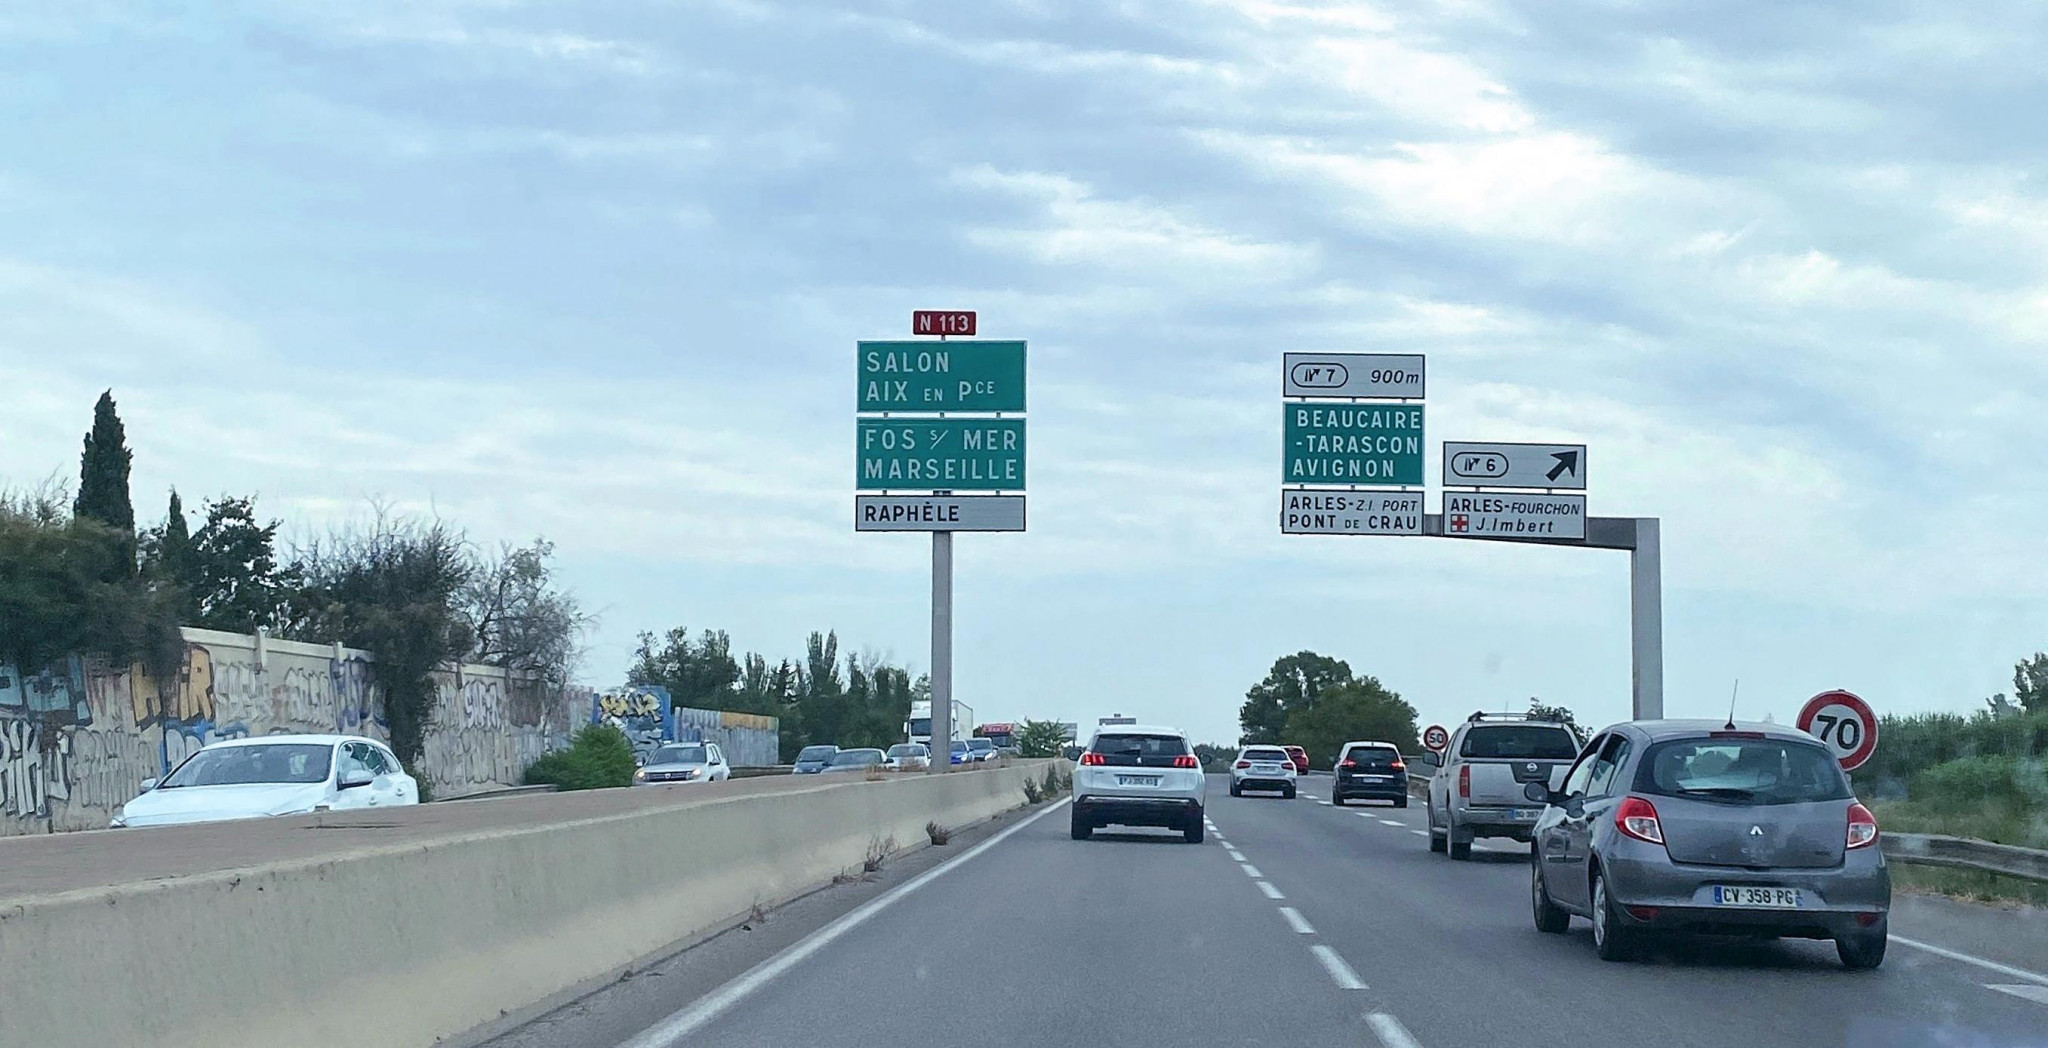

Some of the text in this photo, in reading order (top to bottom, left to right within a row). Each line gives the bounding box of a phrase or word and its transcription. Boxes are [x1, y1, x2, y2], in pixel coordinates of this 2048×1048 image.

[920, 315, 969, 332] N 113
[866, 352, 949, 373] SALON
[1326, 368, 1335, 382] 7
[865, 381, 908, 402] AIX
[924, 388, 943, 401] EN
[1297, 409, 1421, 429] BEAUCAIRE
[865, 429, 916, 450] FOS
[963, 429, 1016, 450] MER
[1296, 435, 1418, 455] -TARASCON
[864, 458, 1017, 480] MARSEILLE
[1292, 459, 1394, 478] AVIGNON
[1486, 457, 1496, 472] 6
[865, 501, 960, 522] RAPHÈLE
[1382, 499, 1418, 512] PORT
[1289, 514, 1417, 530] PONT DE CRAU
[1429, 732, 1444, 744] 50
[1816, 714, 1860, 750] 70
